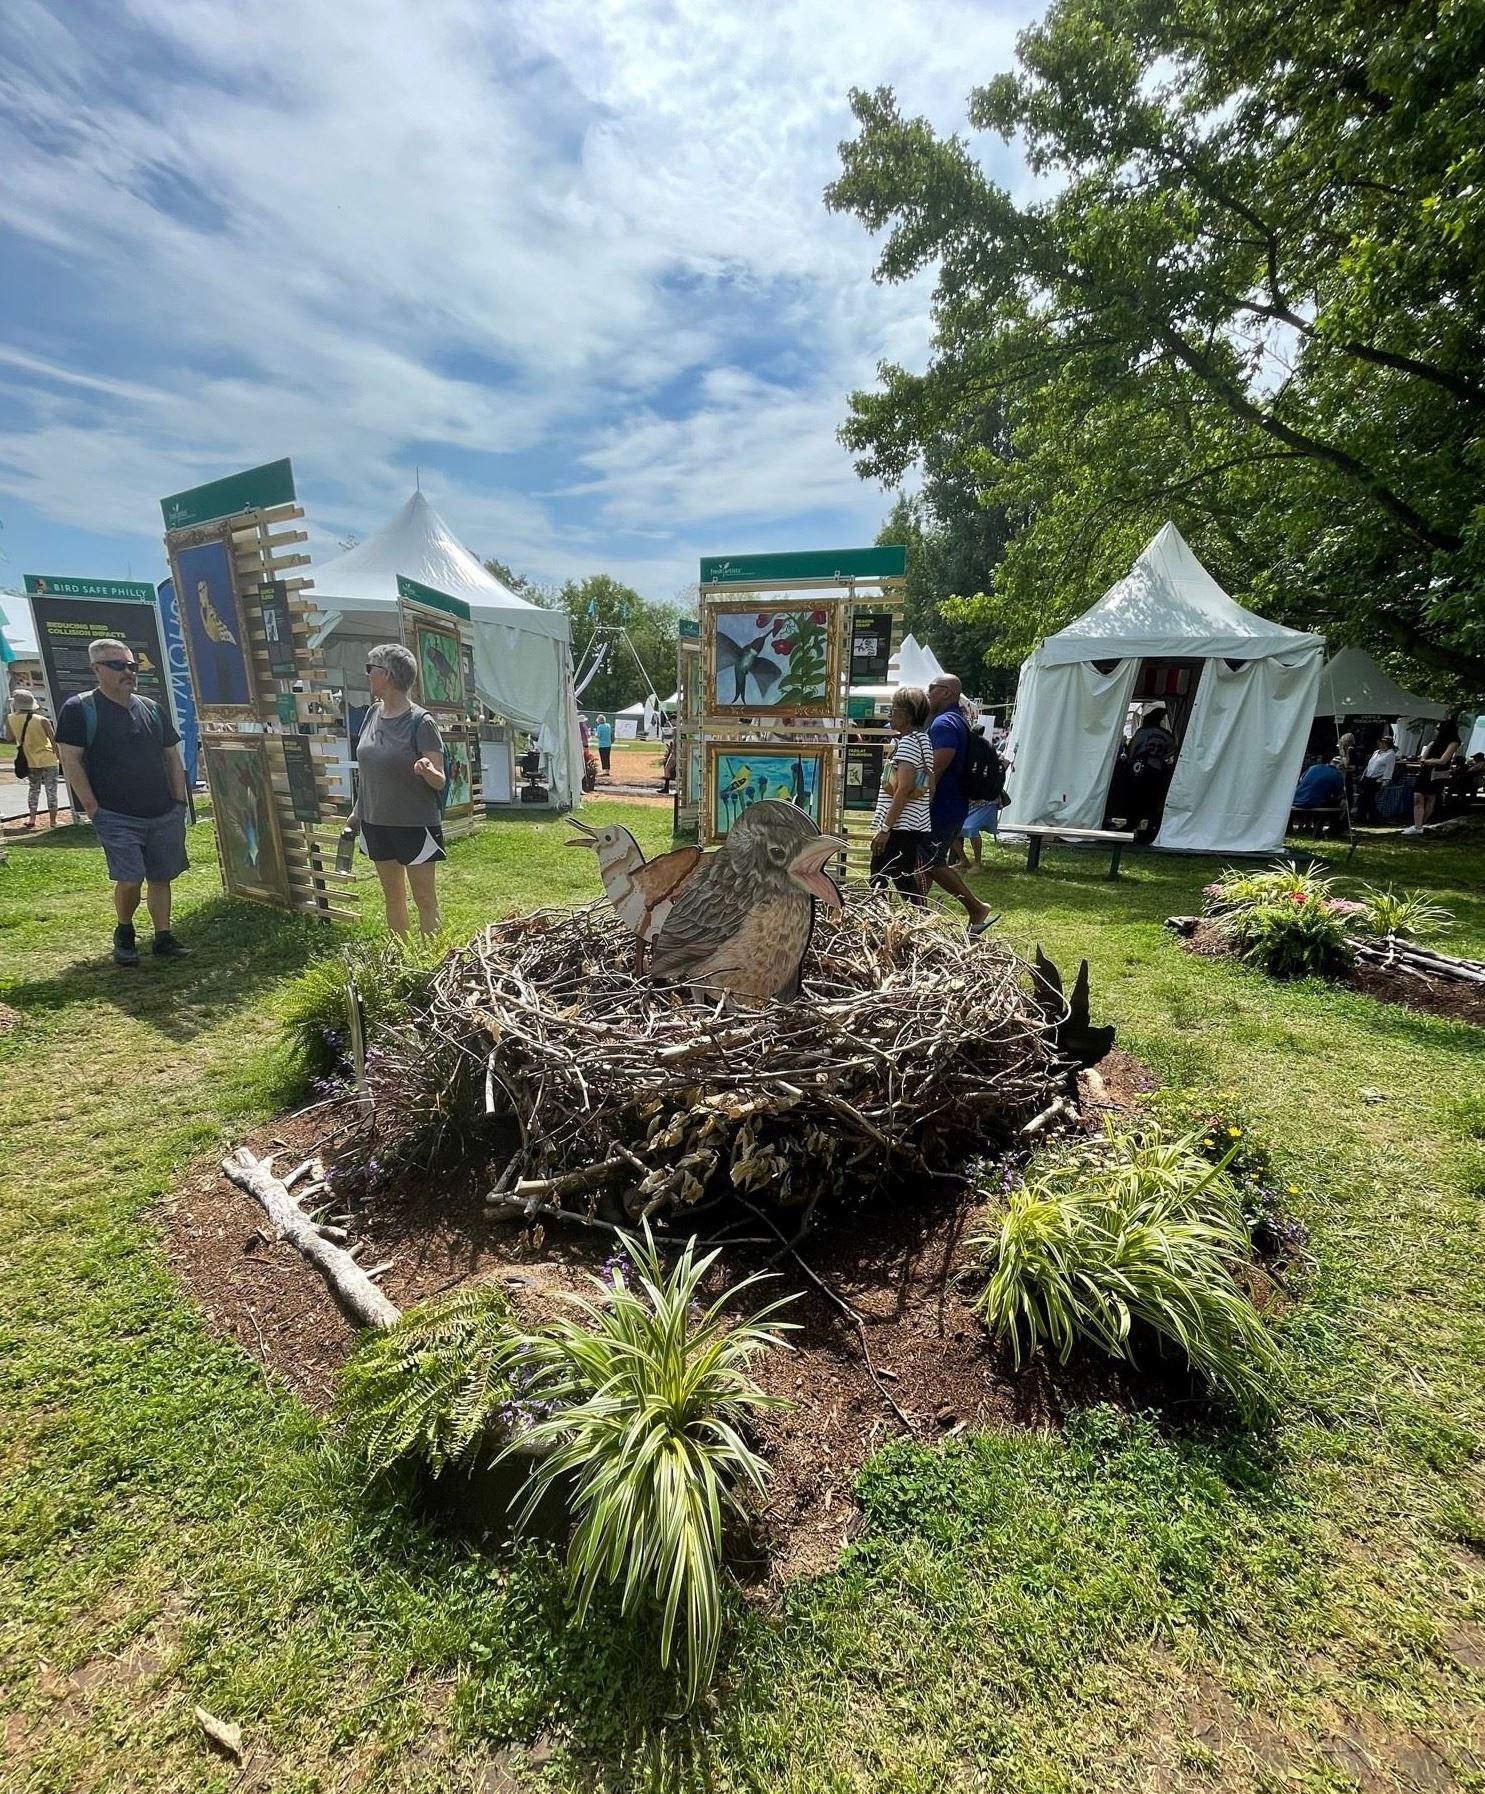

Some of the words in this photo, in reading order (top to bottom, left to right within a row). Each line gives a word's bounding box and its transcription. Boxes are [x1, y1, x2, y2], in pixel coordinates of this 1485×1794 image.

[53, 584, 80, 593] BIRD
[83, 586, 108, 595] SAFE
[111, 589, 147, 598] PHILLY
[46, 622, 89, 631] REDUCING
[47, 629, 91, 637] COLLISION
[92, 631, 127, 639] IMPACTS
